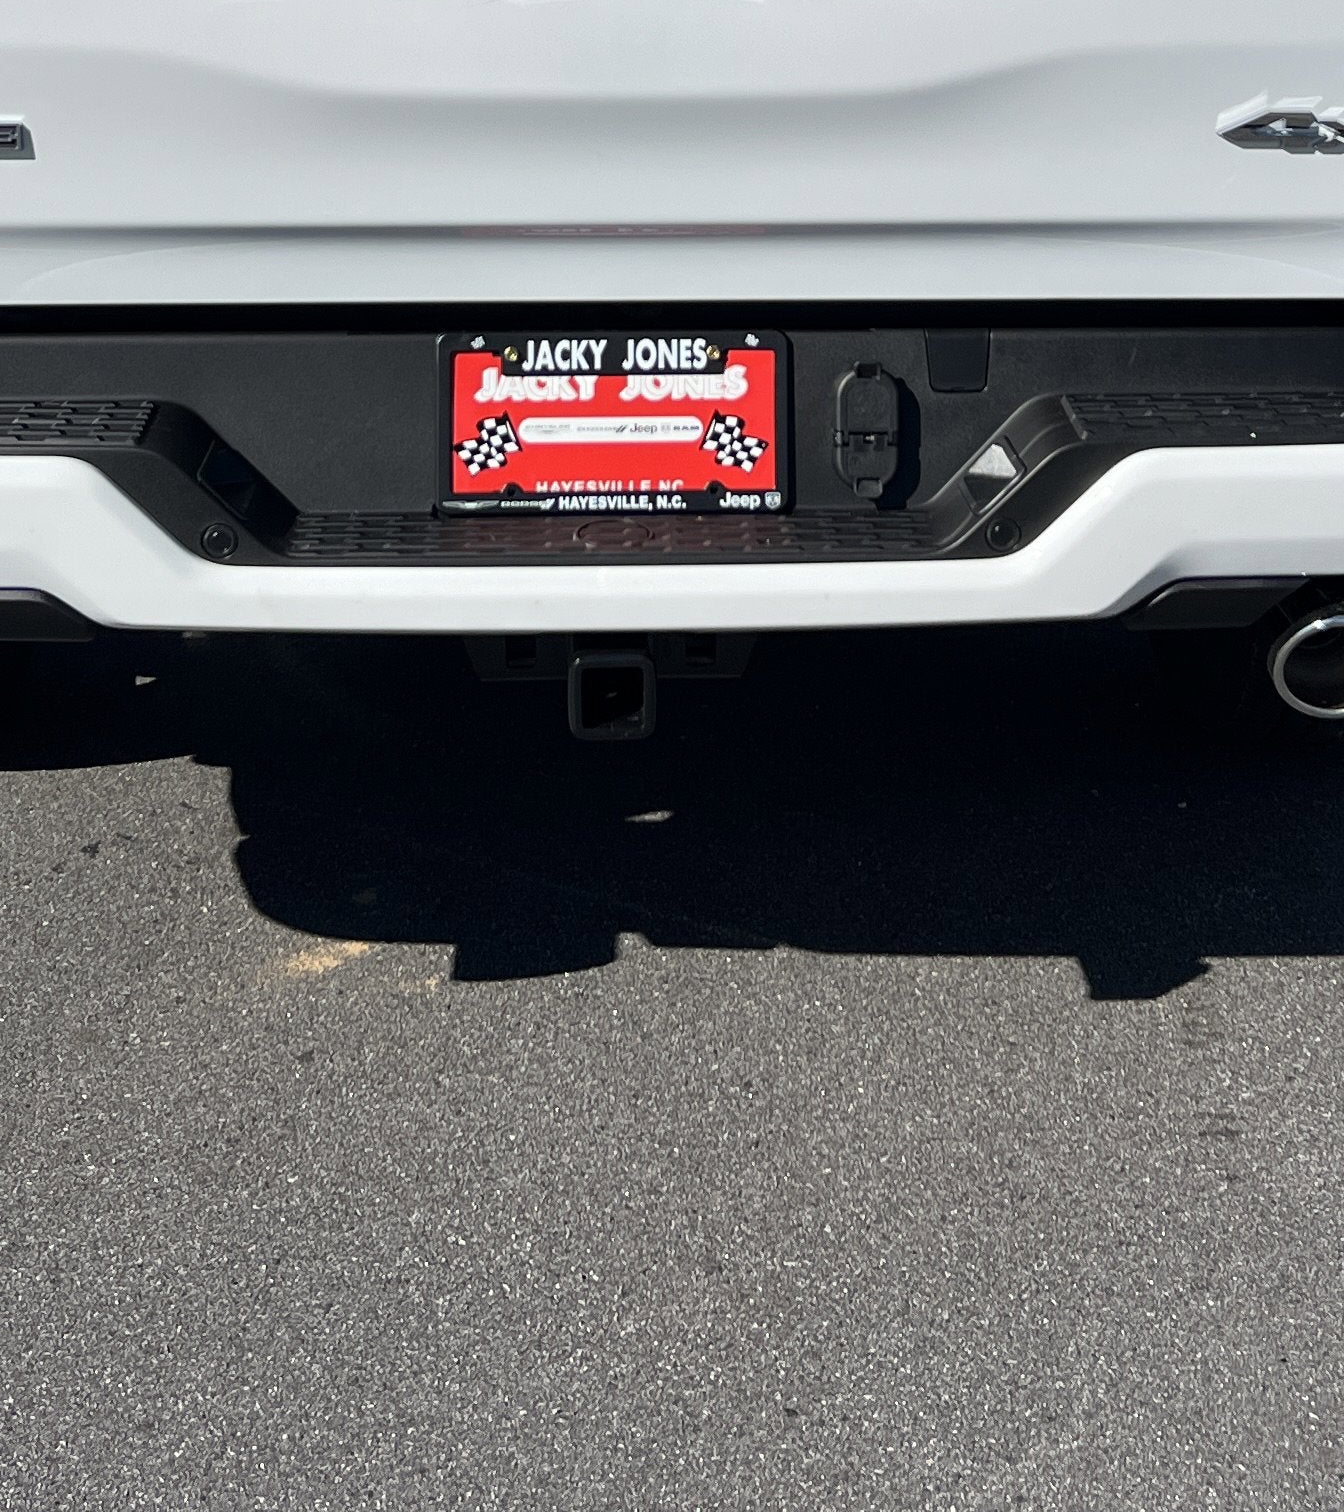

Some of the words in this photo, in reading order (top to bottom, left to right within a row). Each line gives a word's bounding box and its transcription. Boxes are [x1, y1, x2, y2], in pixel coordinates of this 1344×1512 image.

[521, 338, 607, 371] JACKY
[621, 337, 708, 370] JONES
[473, 366, 599, 402] JACKY
[618, 363, 749, 402] JONES
[629, 422, 658, 434] Jeep
[558, 494, 653, 511] HAYESVILLE,
[656, 493, 687, 509] N.C.
[719, 491, 761, 511] Jeep
